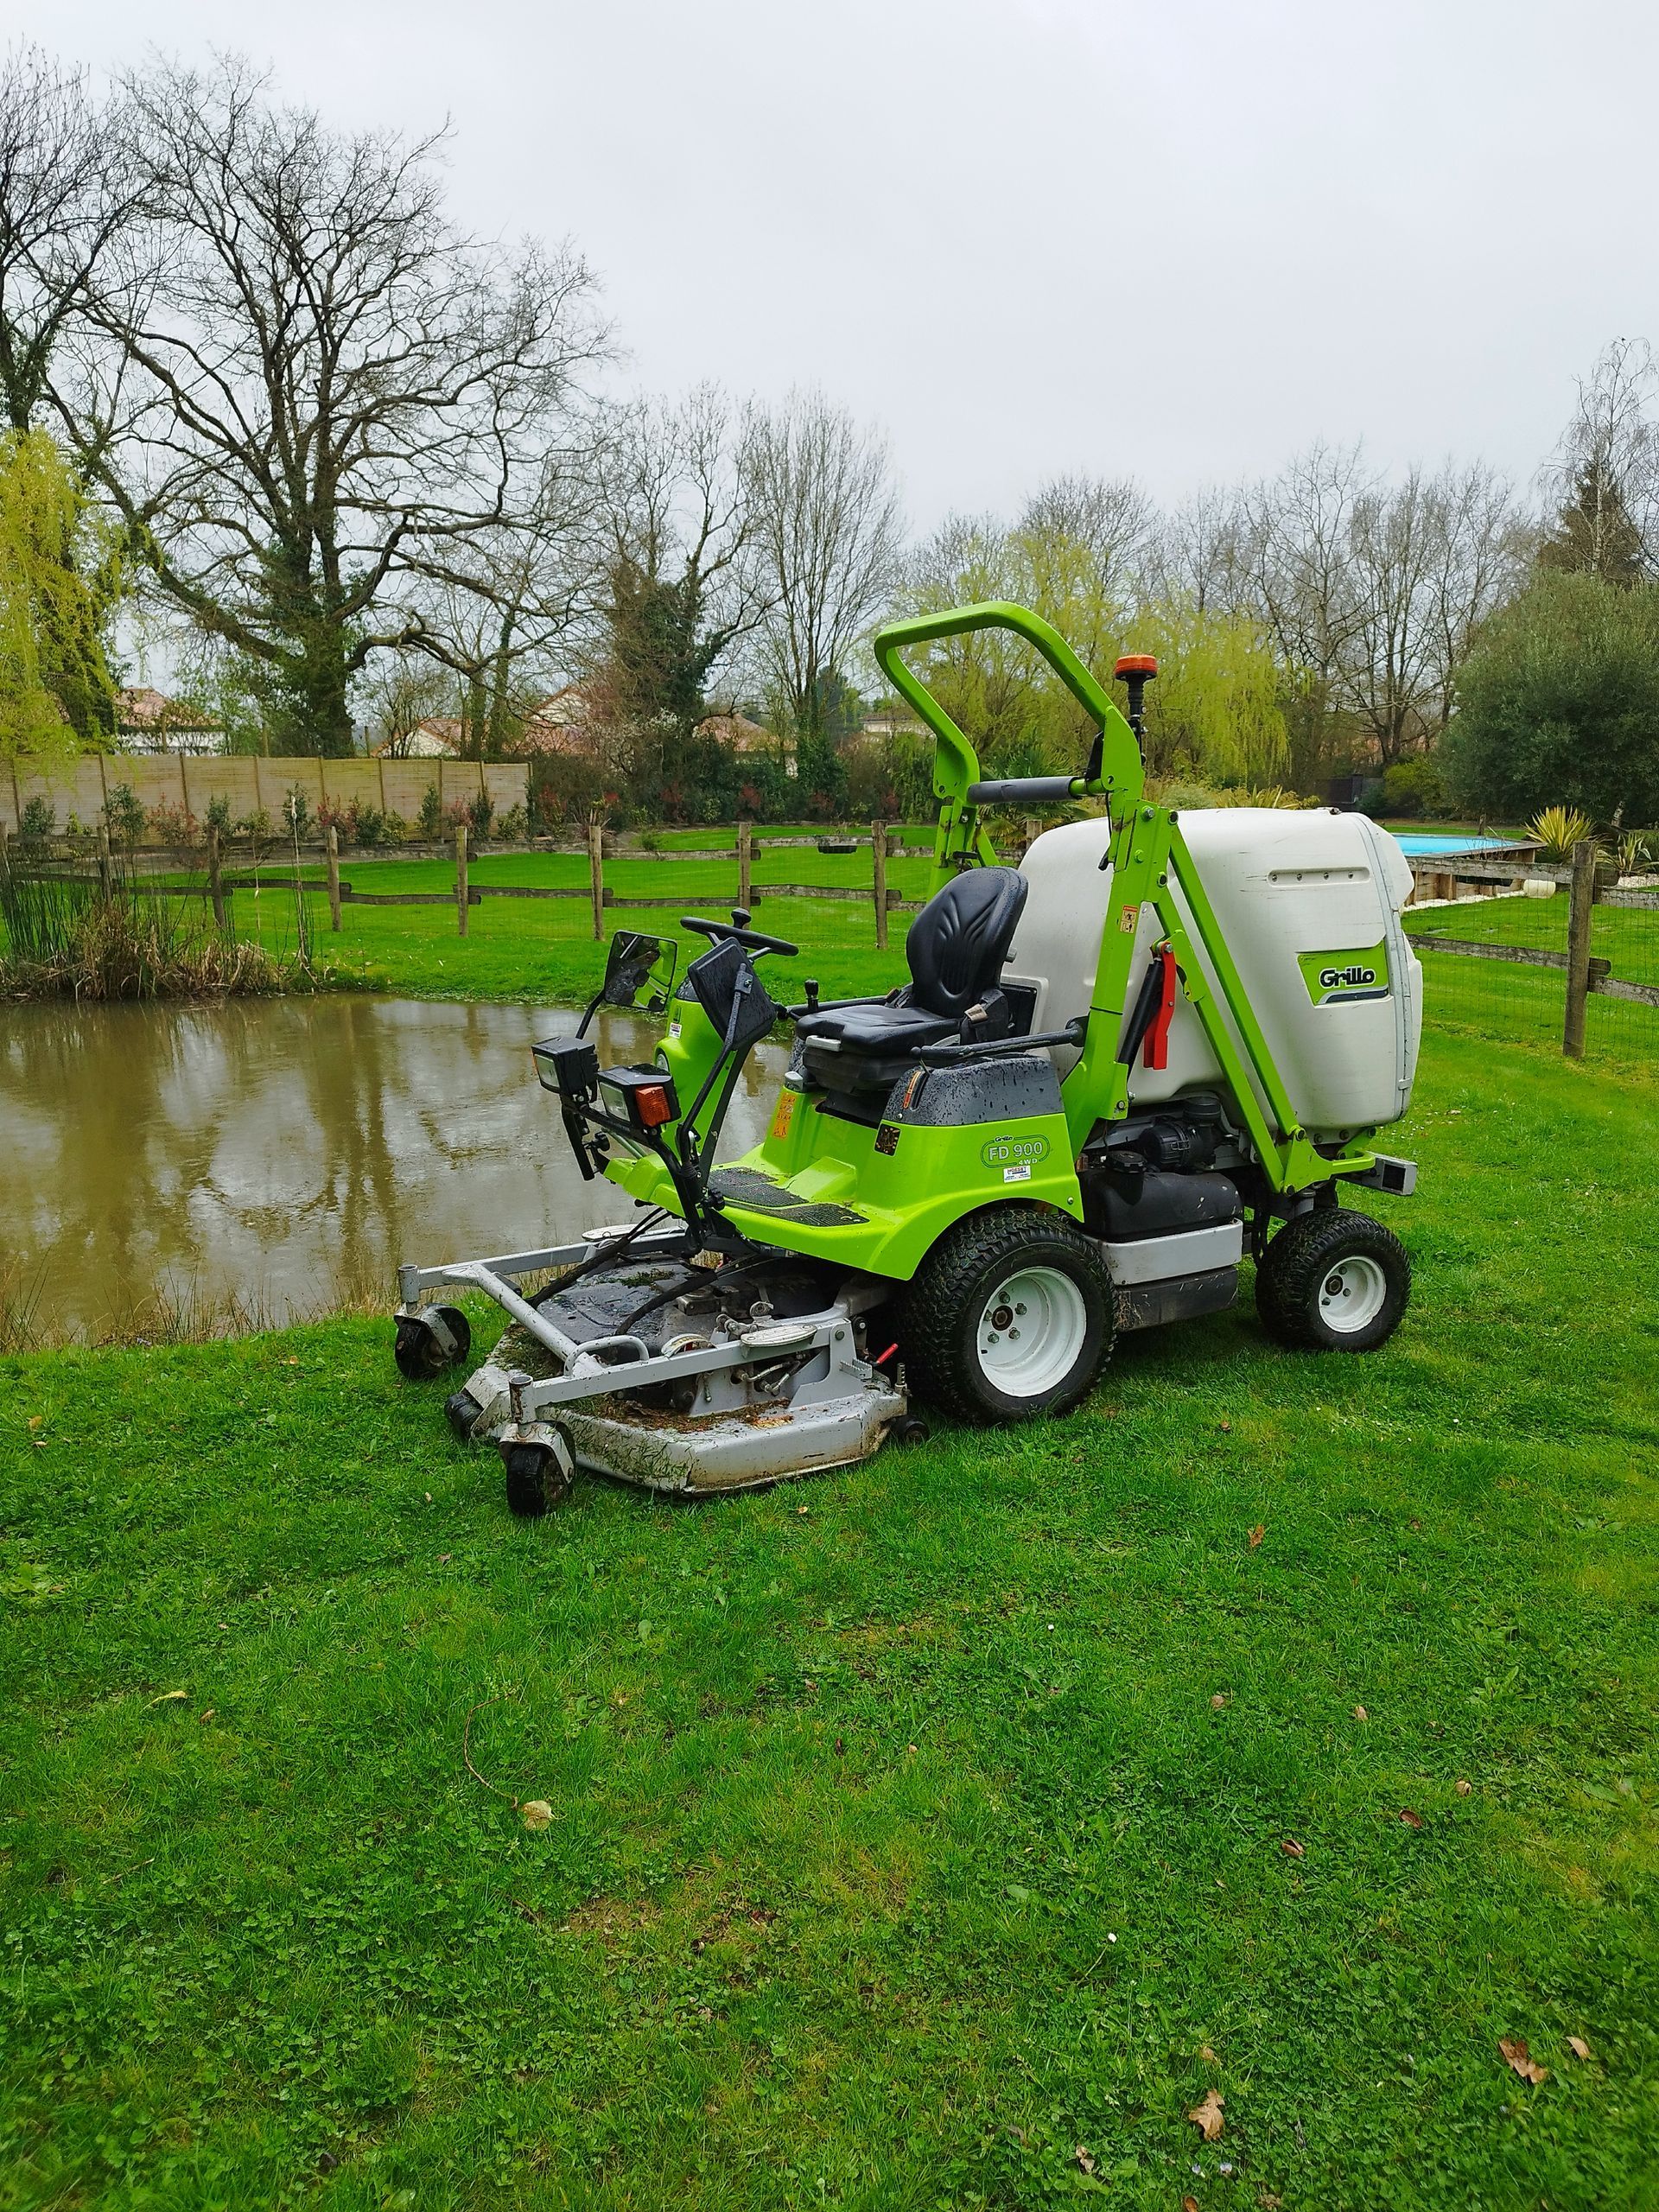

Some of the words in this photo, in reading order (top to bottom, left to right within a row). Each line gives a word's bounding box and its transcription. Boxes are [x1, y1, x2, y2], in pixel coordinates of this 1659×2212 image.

[1319, 966, 1376, 988] Grillo
[988, 1147, 1009, 1160] FD
[1013, 1141, 1043, 1158] 900
